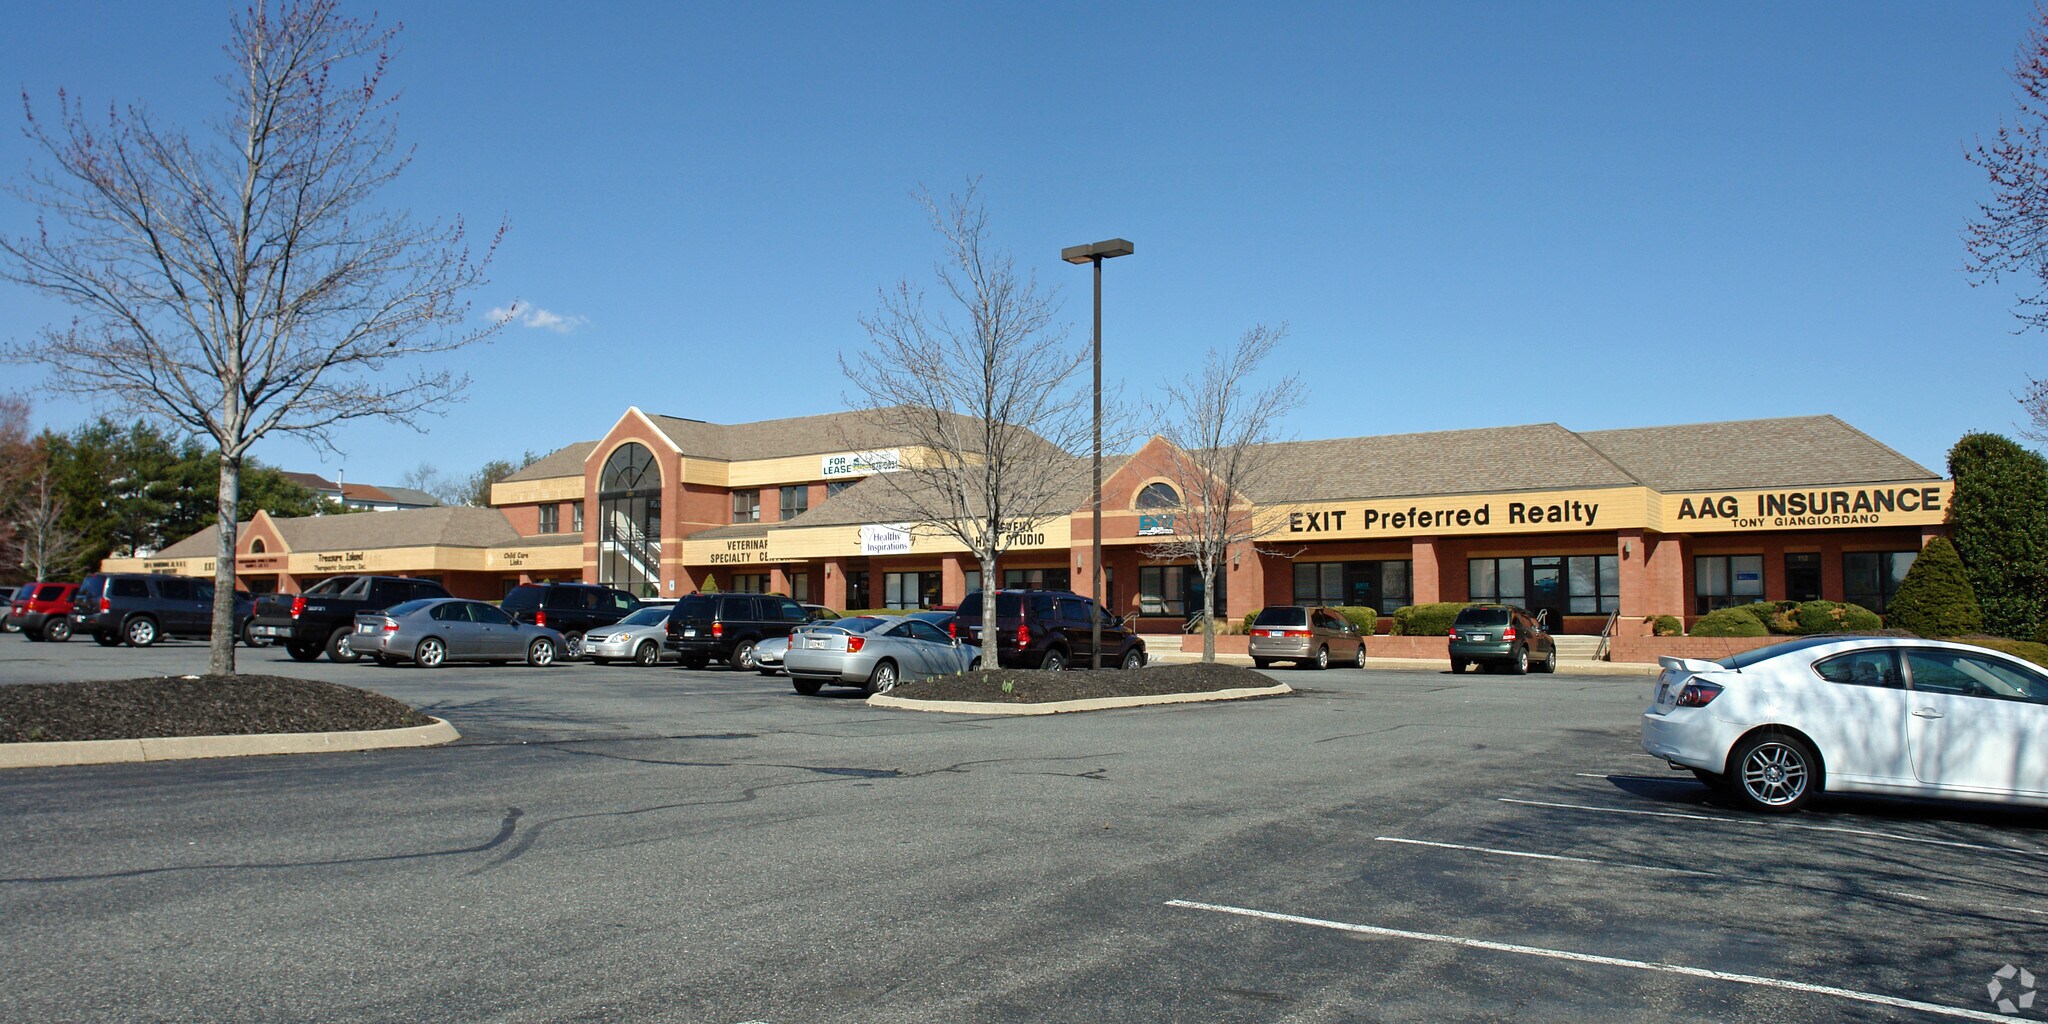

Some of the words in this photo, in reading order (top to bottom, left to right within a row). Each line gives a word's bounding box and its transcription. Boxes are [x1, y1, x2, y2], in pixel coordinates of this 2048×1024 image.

[829, 457, 846, 466] FOR
[823, 465, 852, 475] LEASE
[1677, 496, 1739, 520] AAG
[1757, 487, 1941, 516] INSURANCE
[1289, 510, 1347, 533] EXIT
[1364, 504, 1490, 530] Preferred
[1508, 500, 1599, 526] Realty
[1731, 518, 1765, 528] TONY
[1774, 514, 1879, 526] GIANGIORDANO
[873, 532, 903, 544] Healthy
[867, 542, 908, 554] Inspirations
[318, 553, 343, 562] Treasure
[345, 551, 363, 561] Island
[710, 552, 751, 563] SPECIALTY
